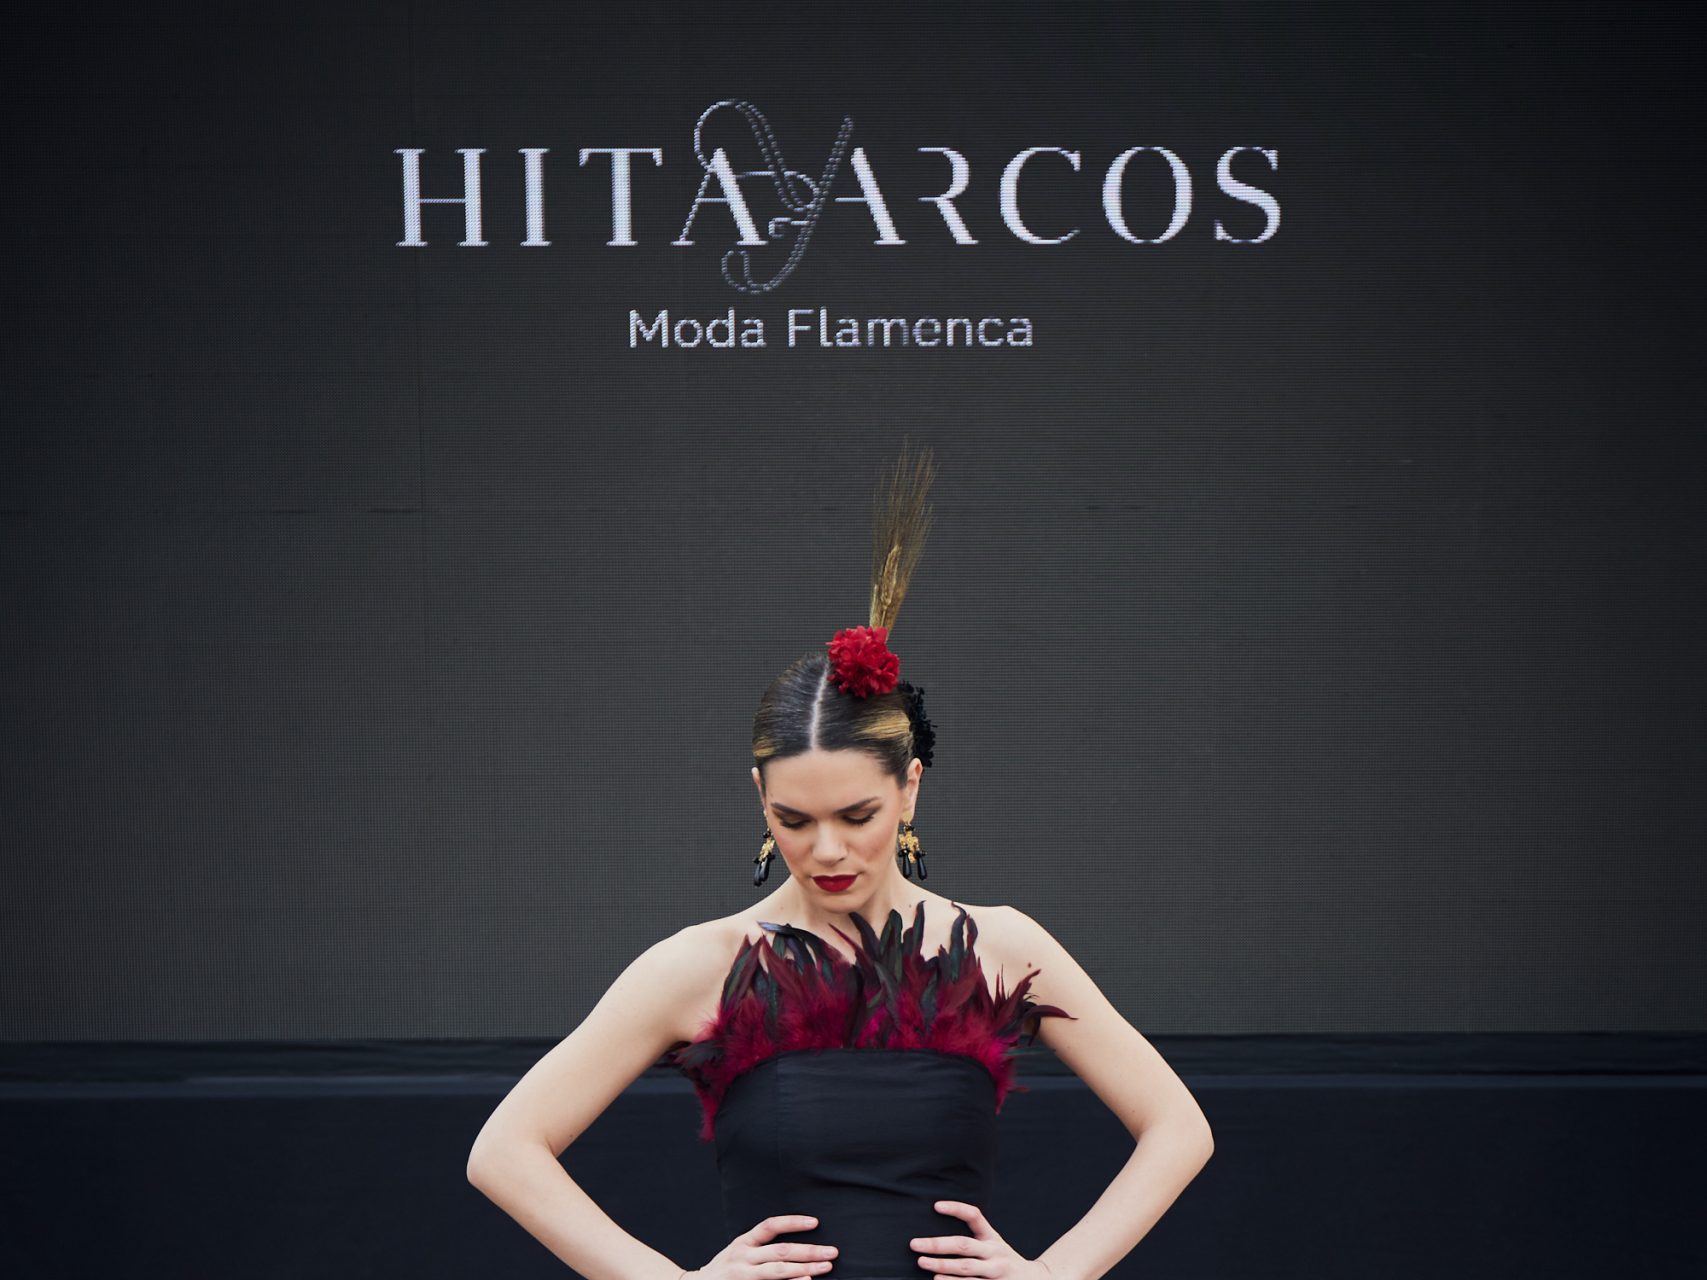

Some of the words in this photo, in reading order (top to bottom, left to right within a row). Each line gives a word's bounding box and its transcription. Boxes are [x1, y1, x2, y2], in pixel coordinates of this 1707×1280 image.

[394, 147, 769, 246] HITA
[833, 146, 1282, 246] ARCOS
[629, 307, 767, 348] Moda
[787, 306, 1034, 348] Flamenca
